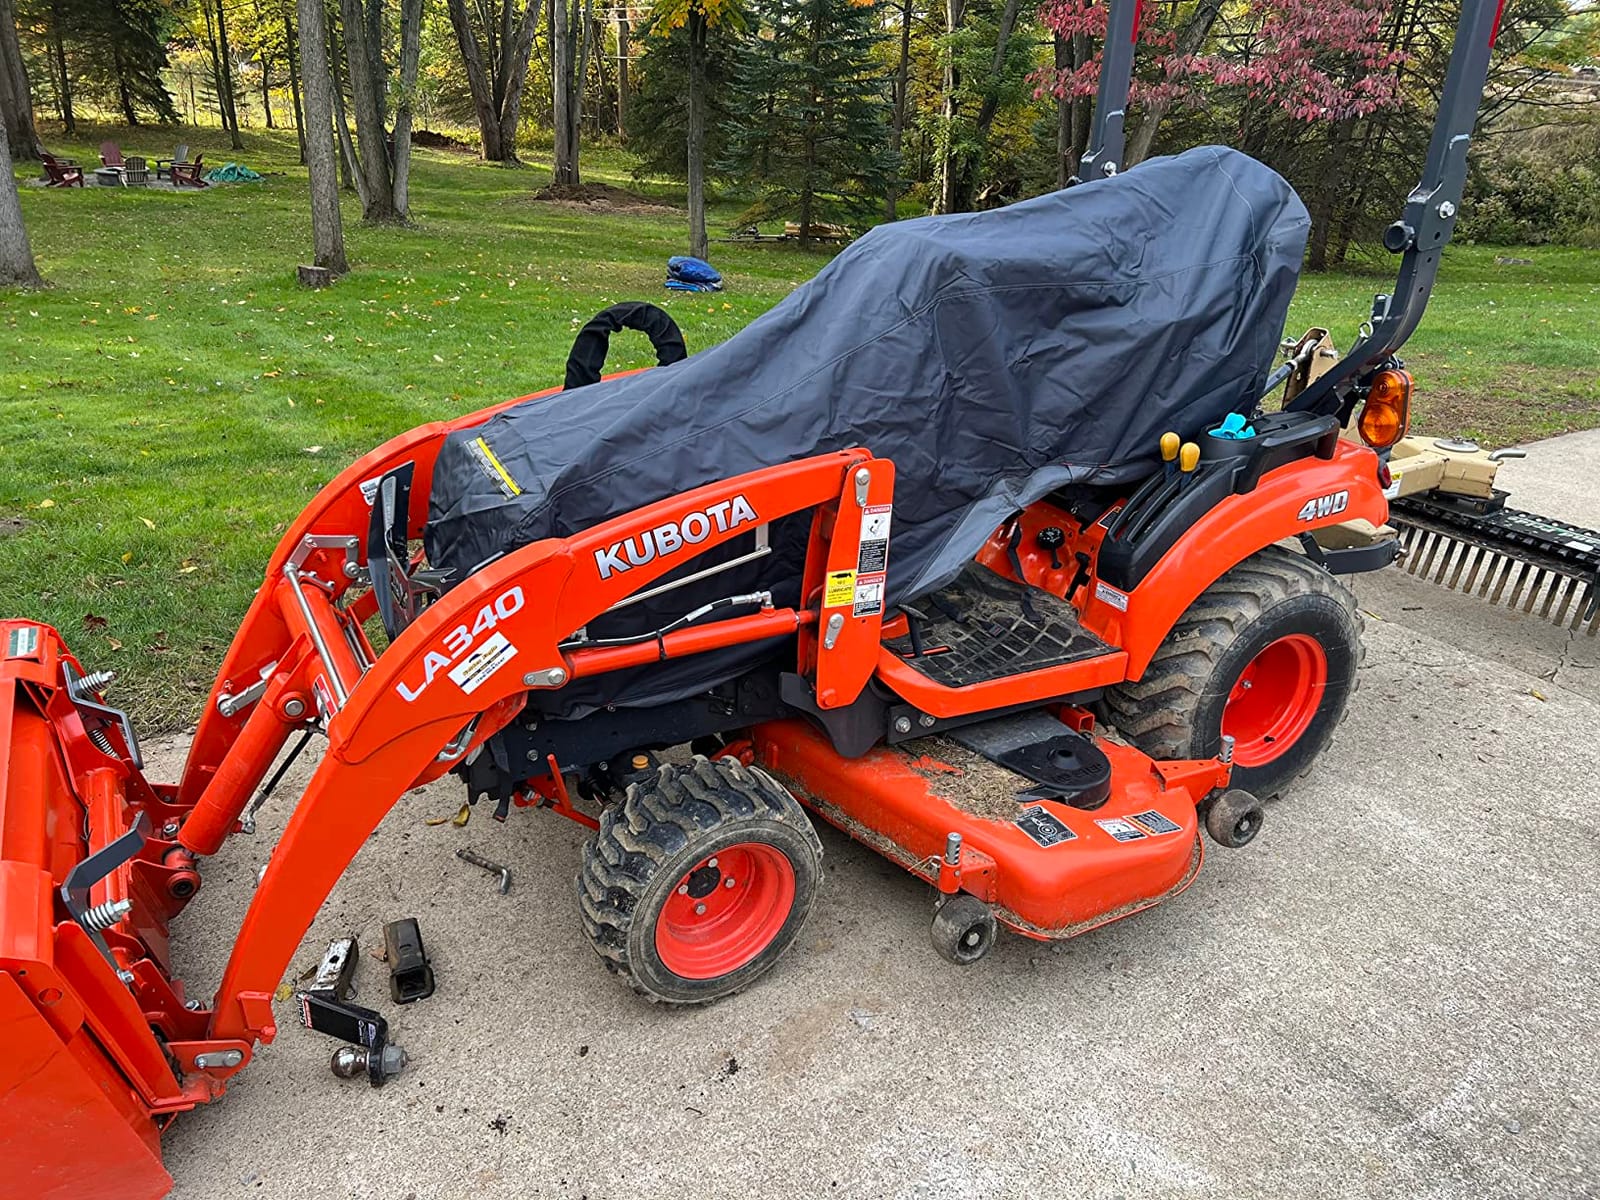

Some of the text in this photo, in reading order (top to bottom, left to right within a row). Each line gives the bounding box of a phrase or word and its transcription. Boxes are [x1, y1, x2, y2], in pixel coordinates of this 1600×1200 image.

[594, 495, 759, 580] KUBOTA
[1297, 489, 1349, 523] 4WD
[395, 585, 525, 702] LA340
